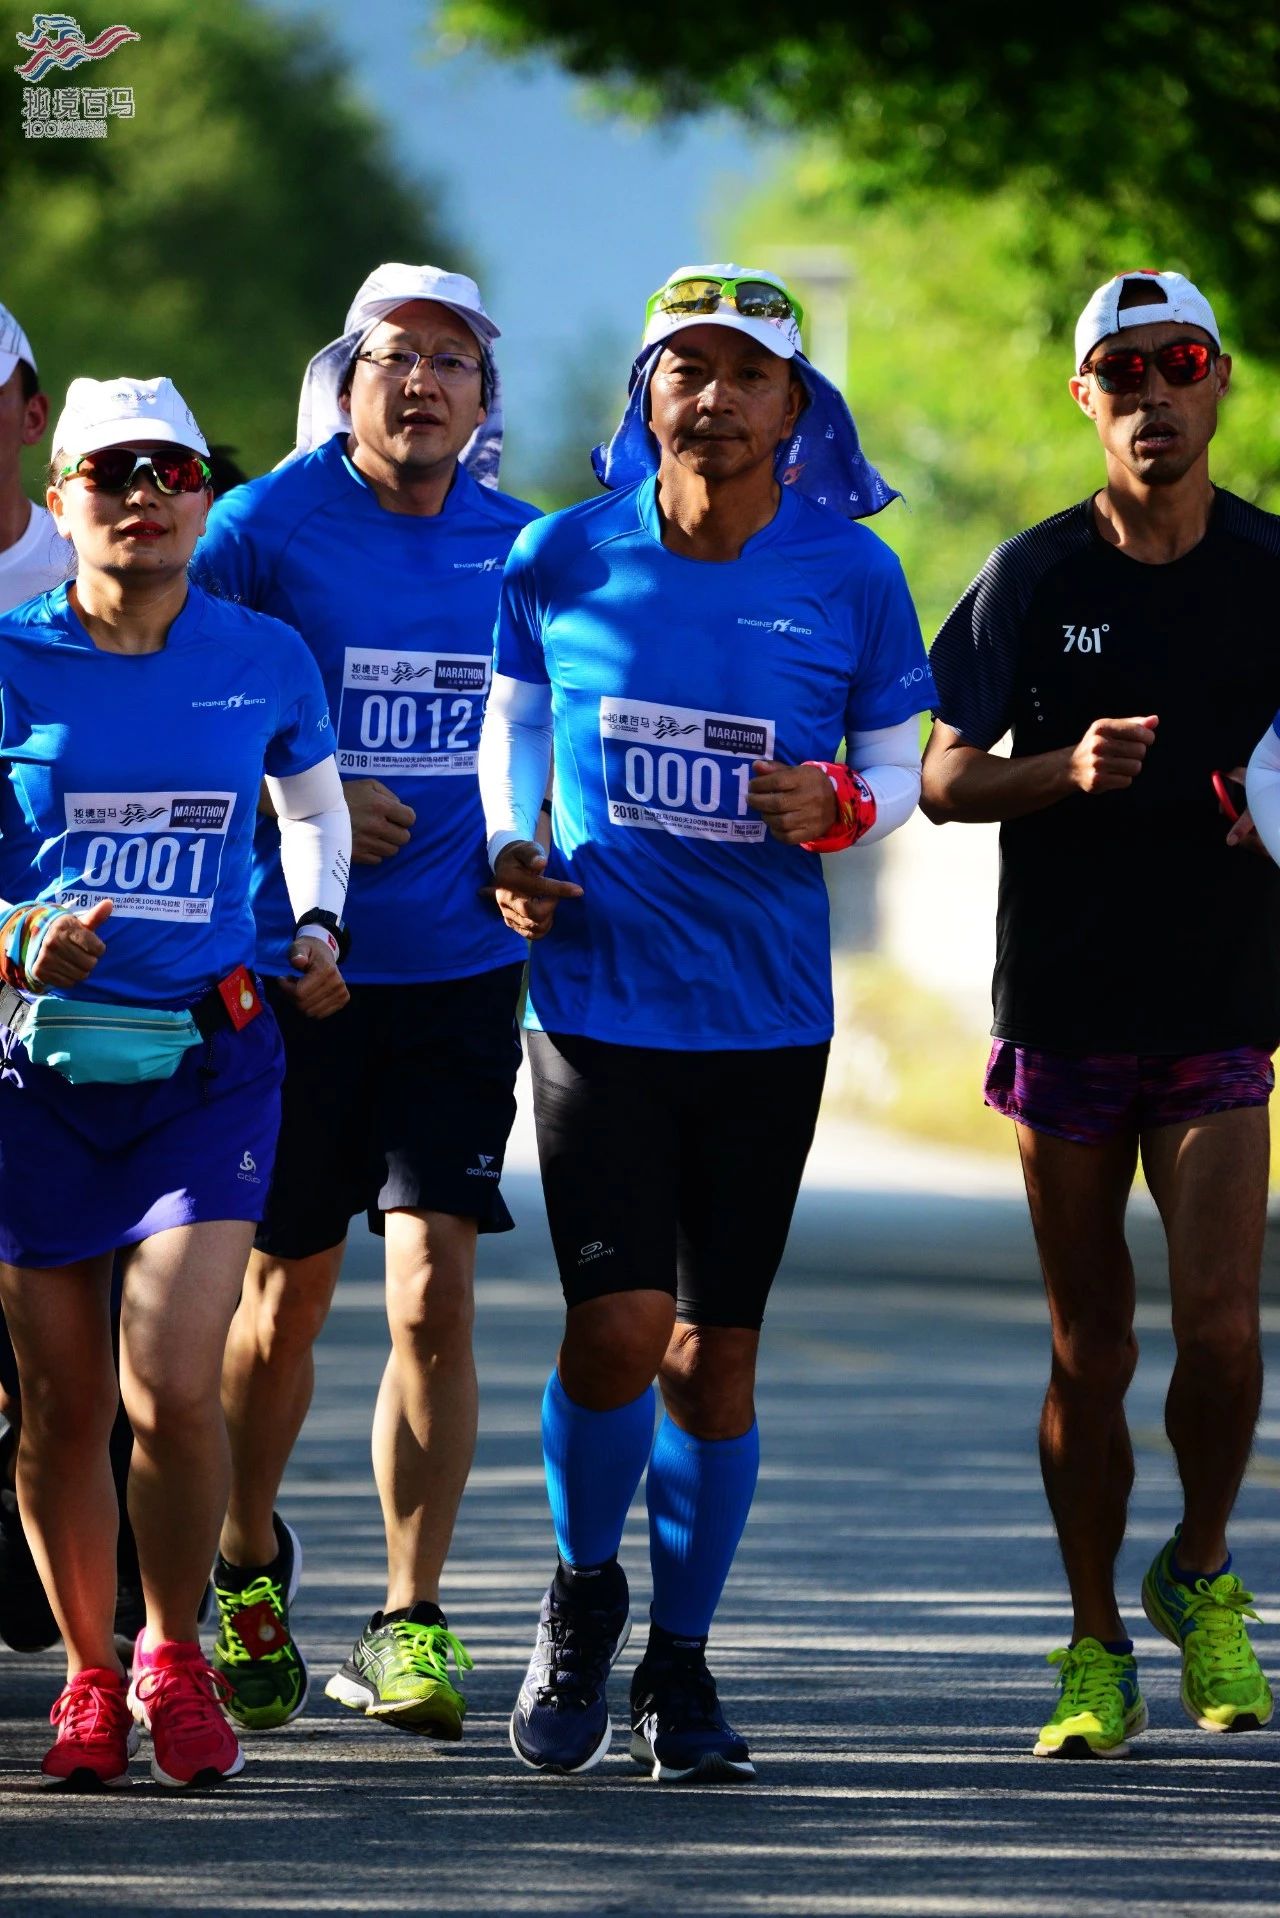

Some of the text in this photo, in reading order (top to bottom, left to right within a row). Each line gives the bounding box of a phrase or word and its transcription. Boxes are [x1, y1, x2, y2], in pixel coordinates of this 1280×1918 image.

[737, 617, 812, 635] ENGINE BIRD
[438, 666, 484, 680] MARATHON
[192, 700, 227, 708] ENGINE
[360, 694, 473, 749] 0012
[707, 725, 764, 745] MARATHON
[340, 753, 367, 768] 2018
[625, 747, 750, 816] 0001
[174, 805, 225, 818] MARATHON
[613, 804, 639, 821] 2018
[82, 836, 207, 893] 0001
[61, 892, 89, 907] 2018
